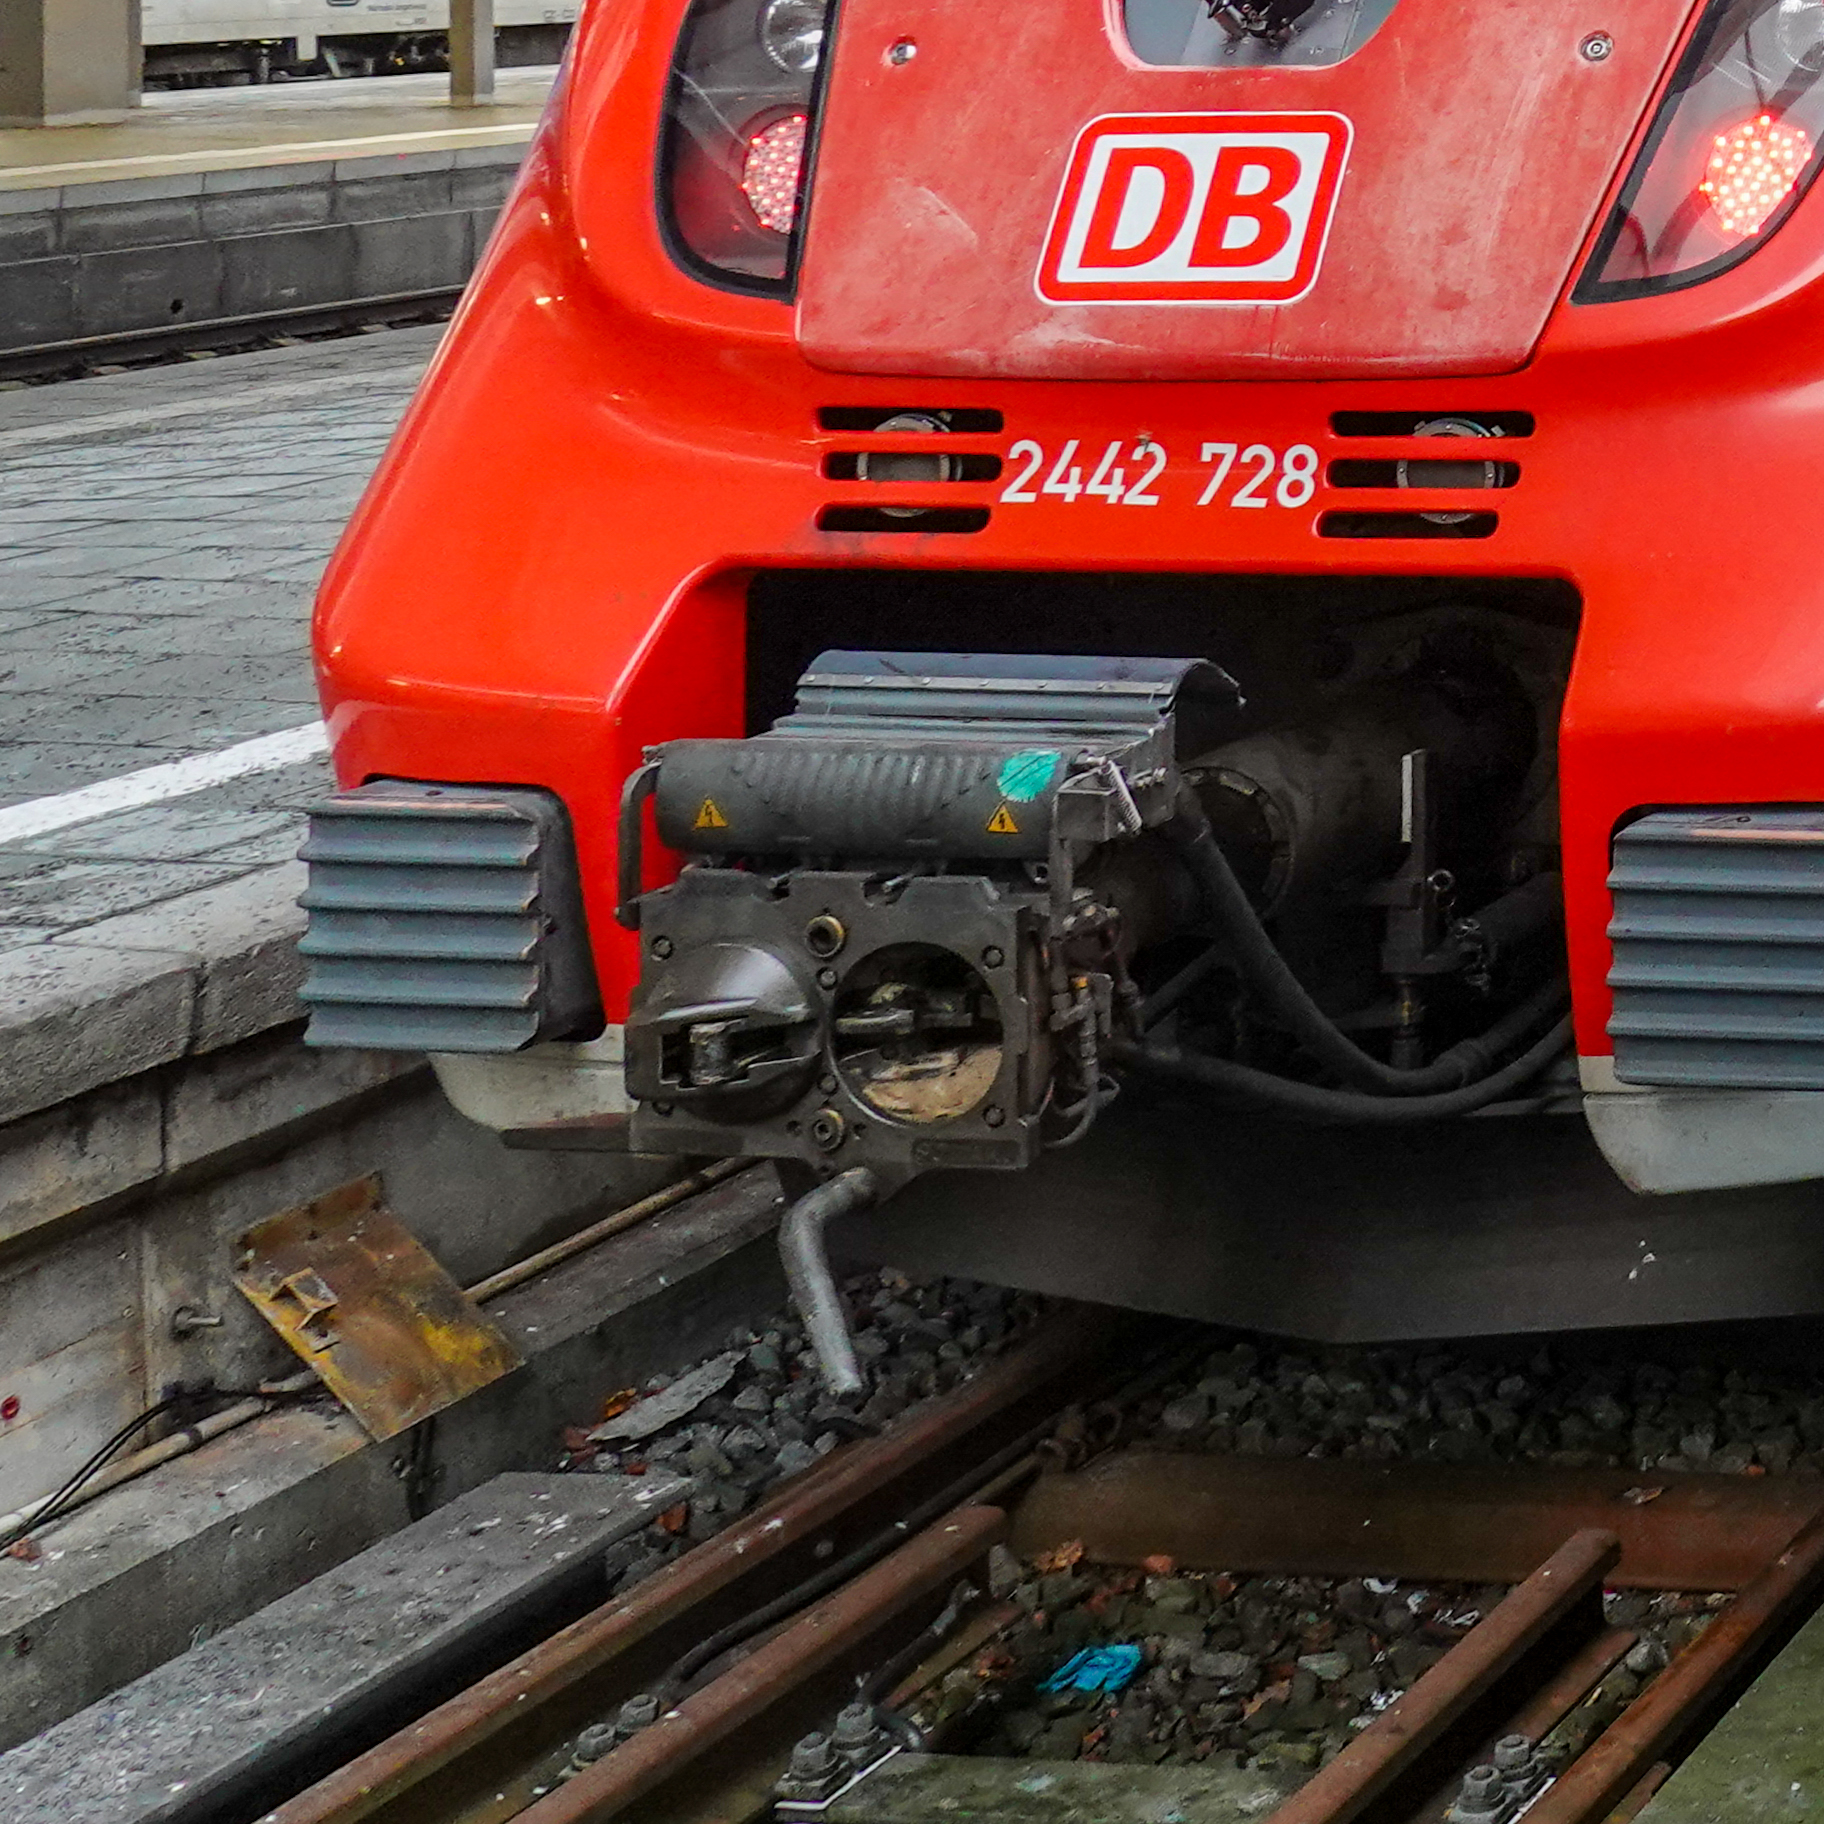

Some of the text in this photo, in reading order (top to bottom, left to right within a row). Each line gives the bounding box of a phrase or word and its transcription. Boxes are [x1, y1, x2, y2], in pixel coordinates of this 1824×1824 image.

[1078, 145, 1303, 269] DB
[999, 438, 1321, 510] 2442 728
